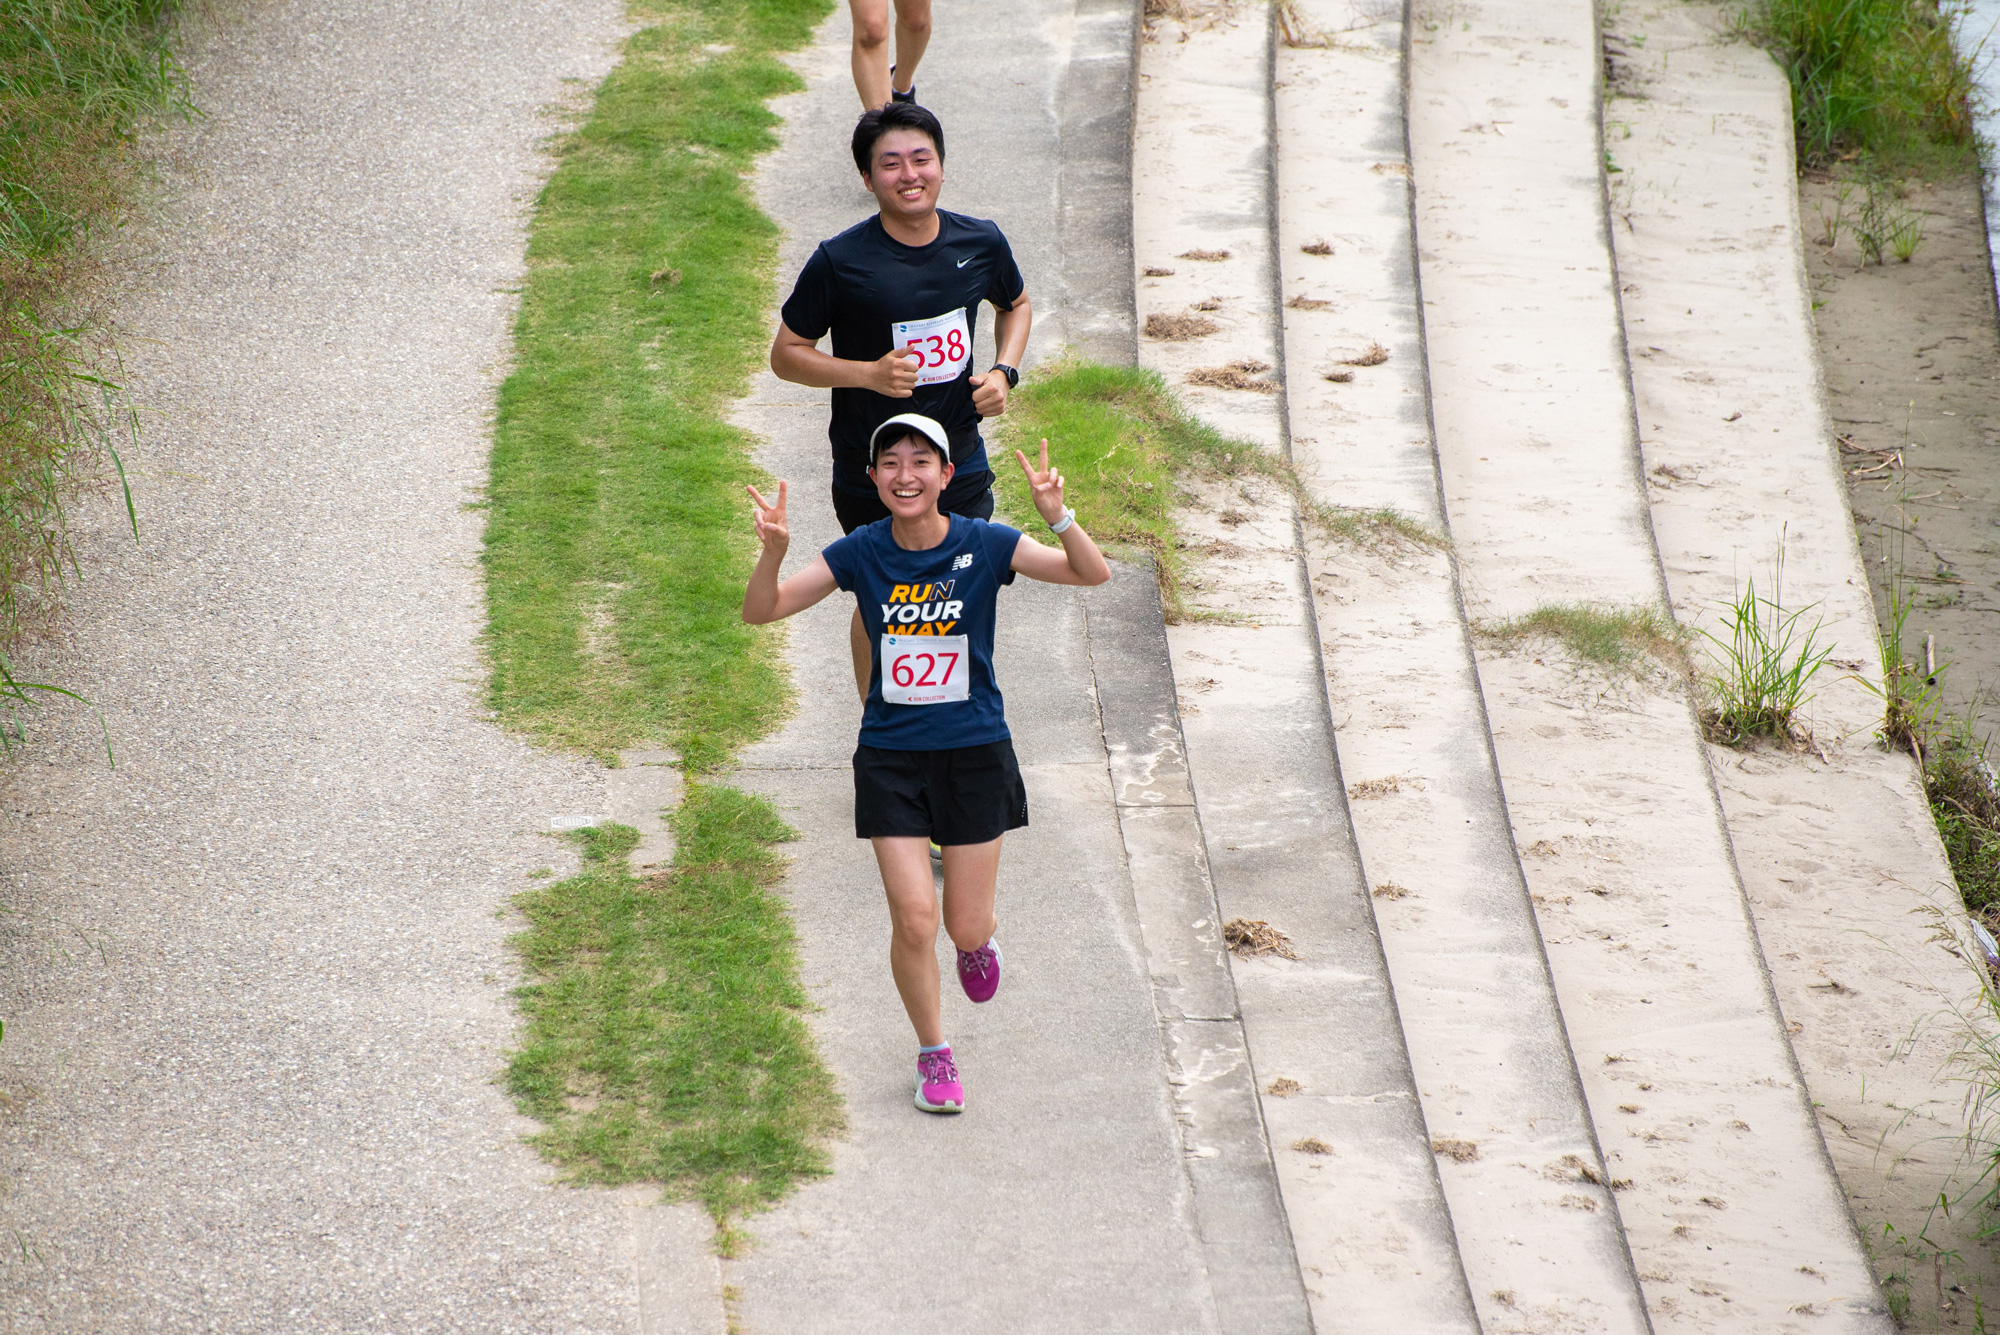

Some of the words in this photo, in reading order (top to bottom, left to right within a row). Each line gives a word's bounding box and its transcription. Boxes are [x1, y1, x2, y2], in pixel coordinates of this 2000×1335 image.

[906, 329, 965, 369] 538
[935, 372, 956, 381] COLLECTION
[888, 579, 956, 604] RUN
[881, 600, 964, 623] YOUR
[887, 621, 957, 636] WAY
[891, 652, 959, 688] 627
